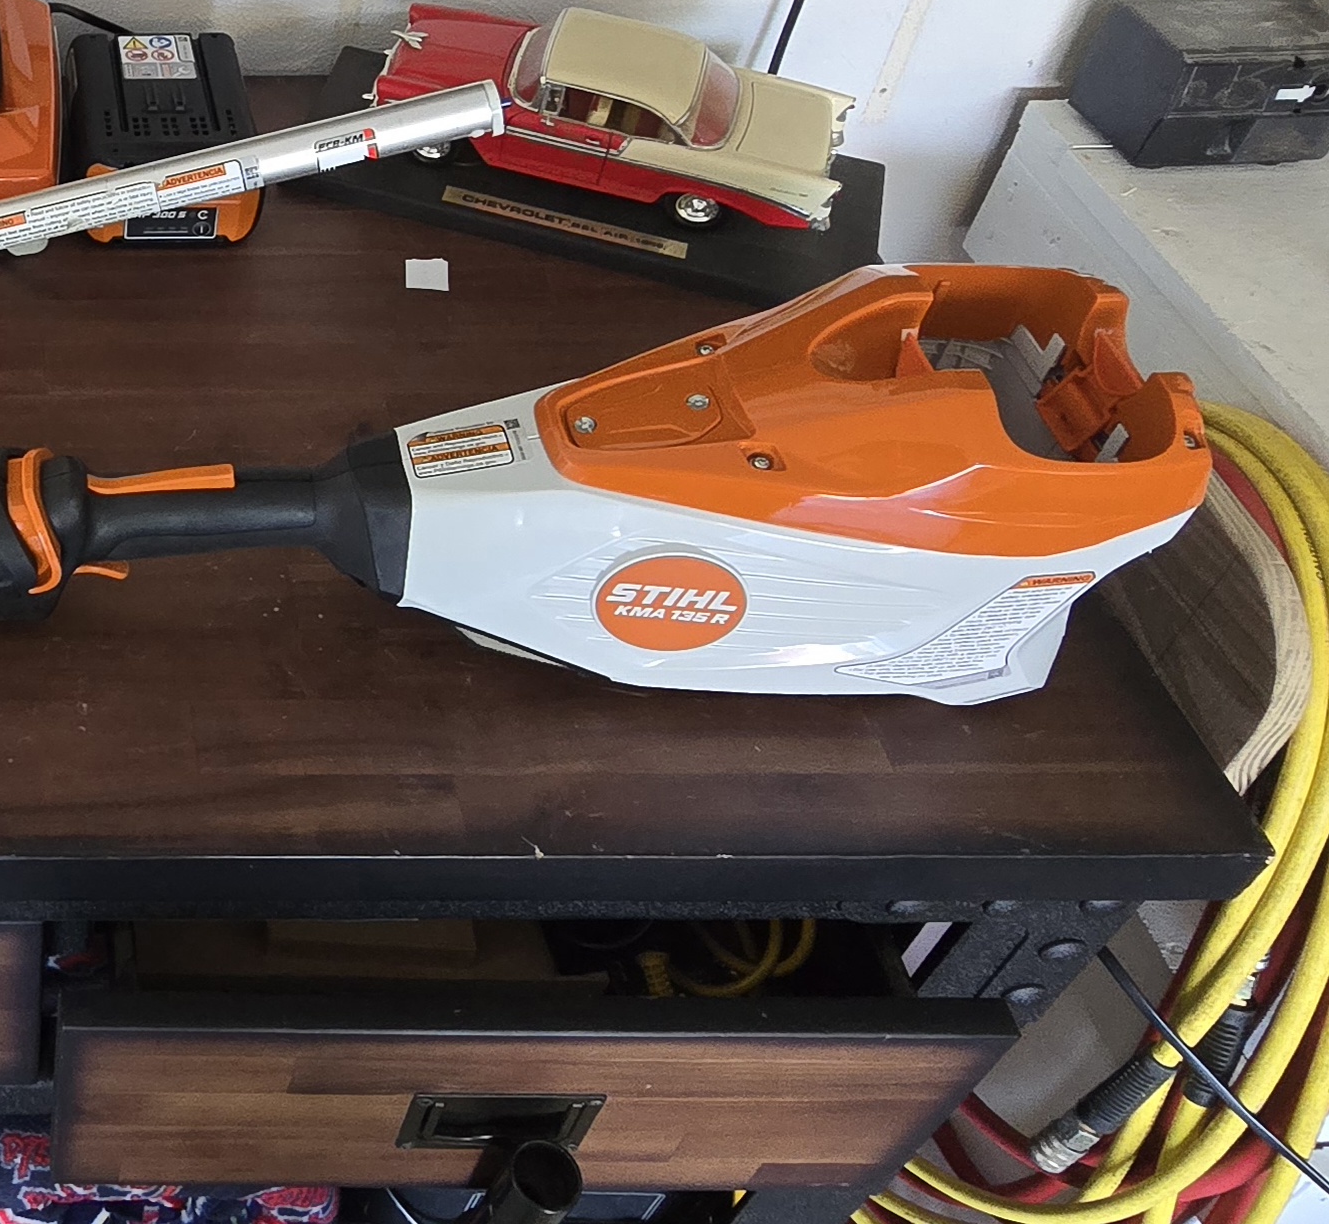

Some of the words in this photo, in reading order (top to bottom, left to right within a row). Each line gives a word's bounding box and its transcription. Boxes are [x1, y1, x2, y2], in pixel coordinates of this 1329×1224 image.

[165, 167, 223, 186] ADVERTENCIA
[462, 193, 569, 226] CHEVROLET
[604, 230, 628, 241] AIR
[605, 583, 738, 612] STIHL
[614, 605, 666, 619] KMA
[671, 610, 710, 624] 135
[710, 613, 730, 625] R
